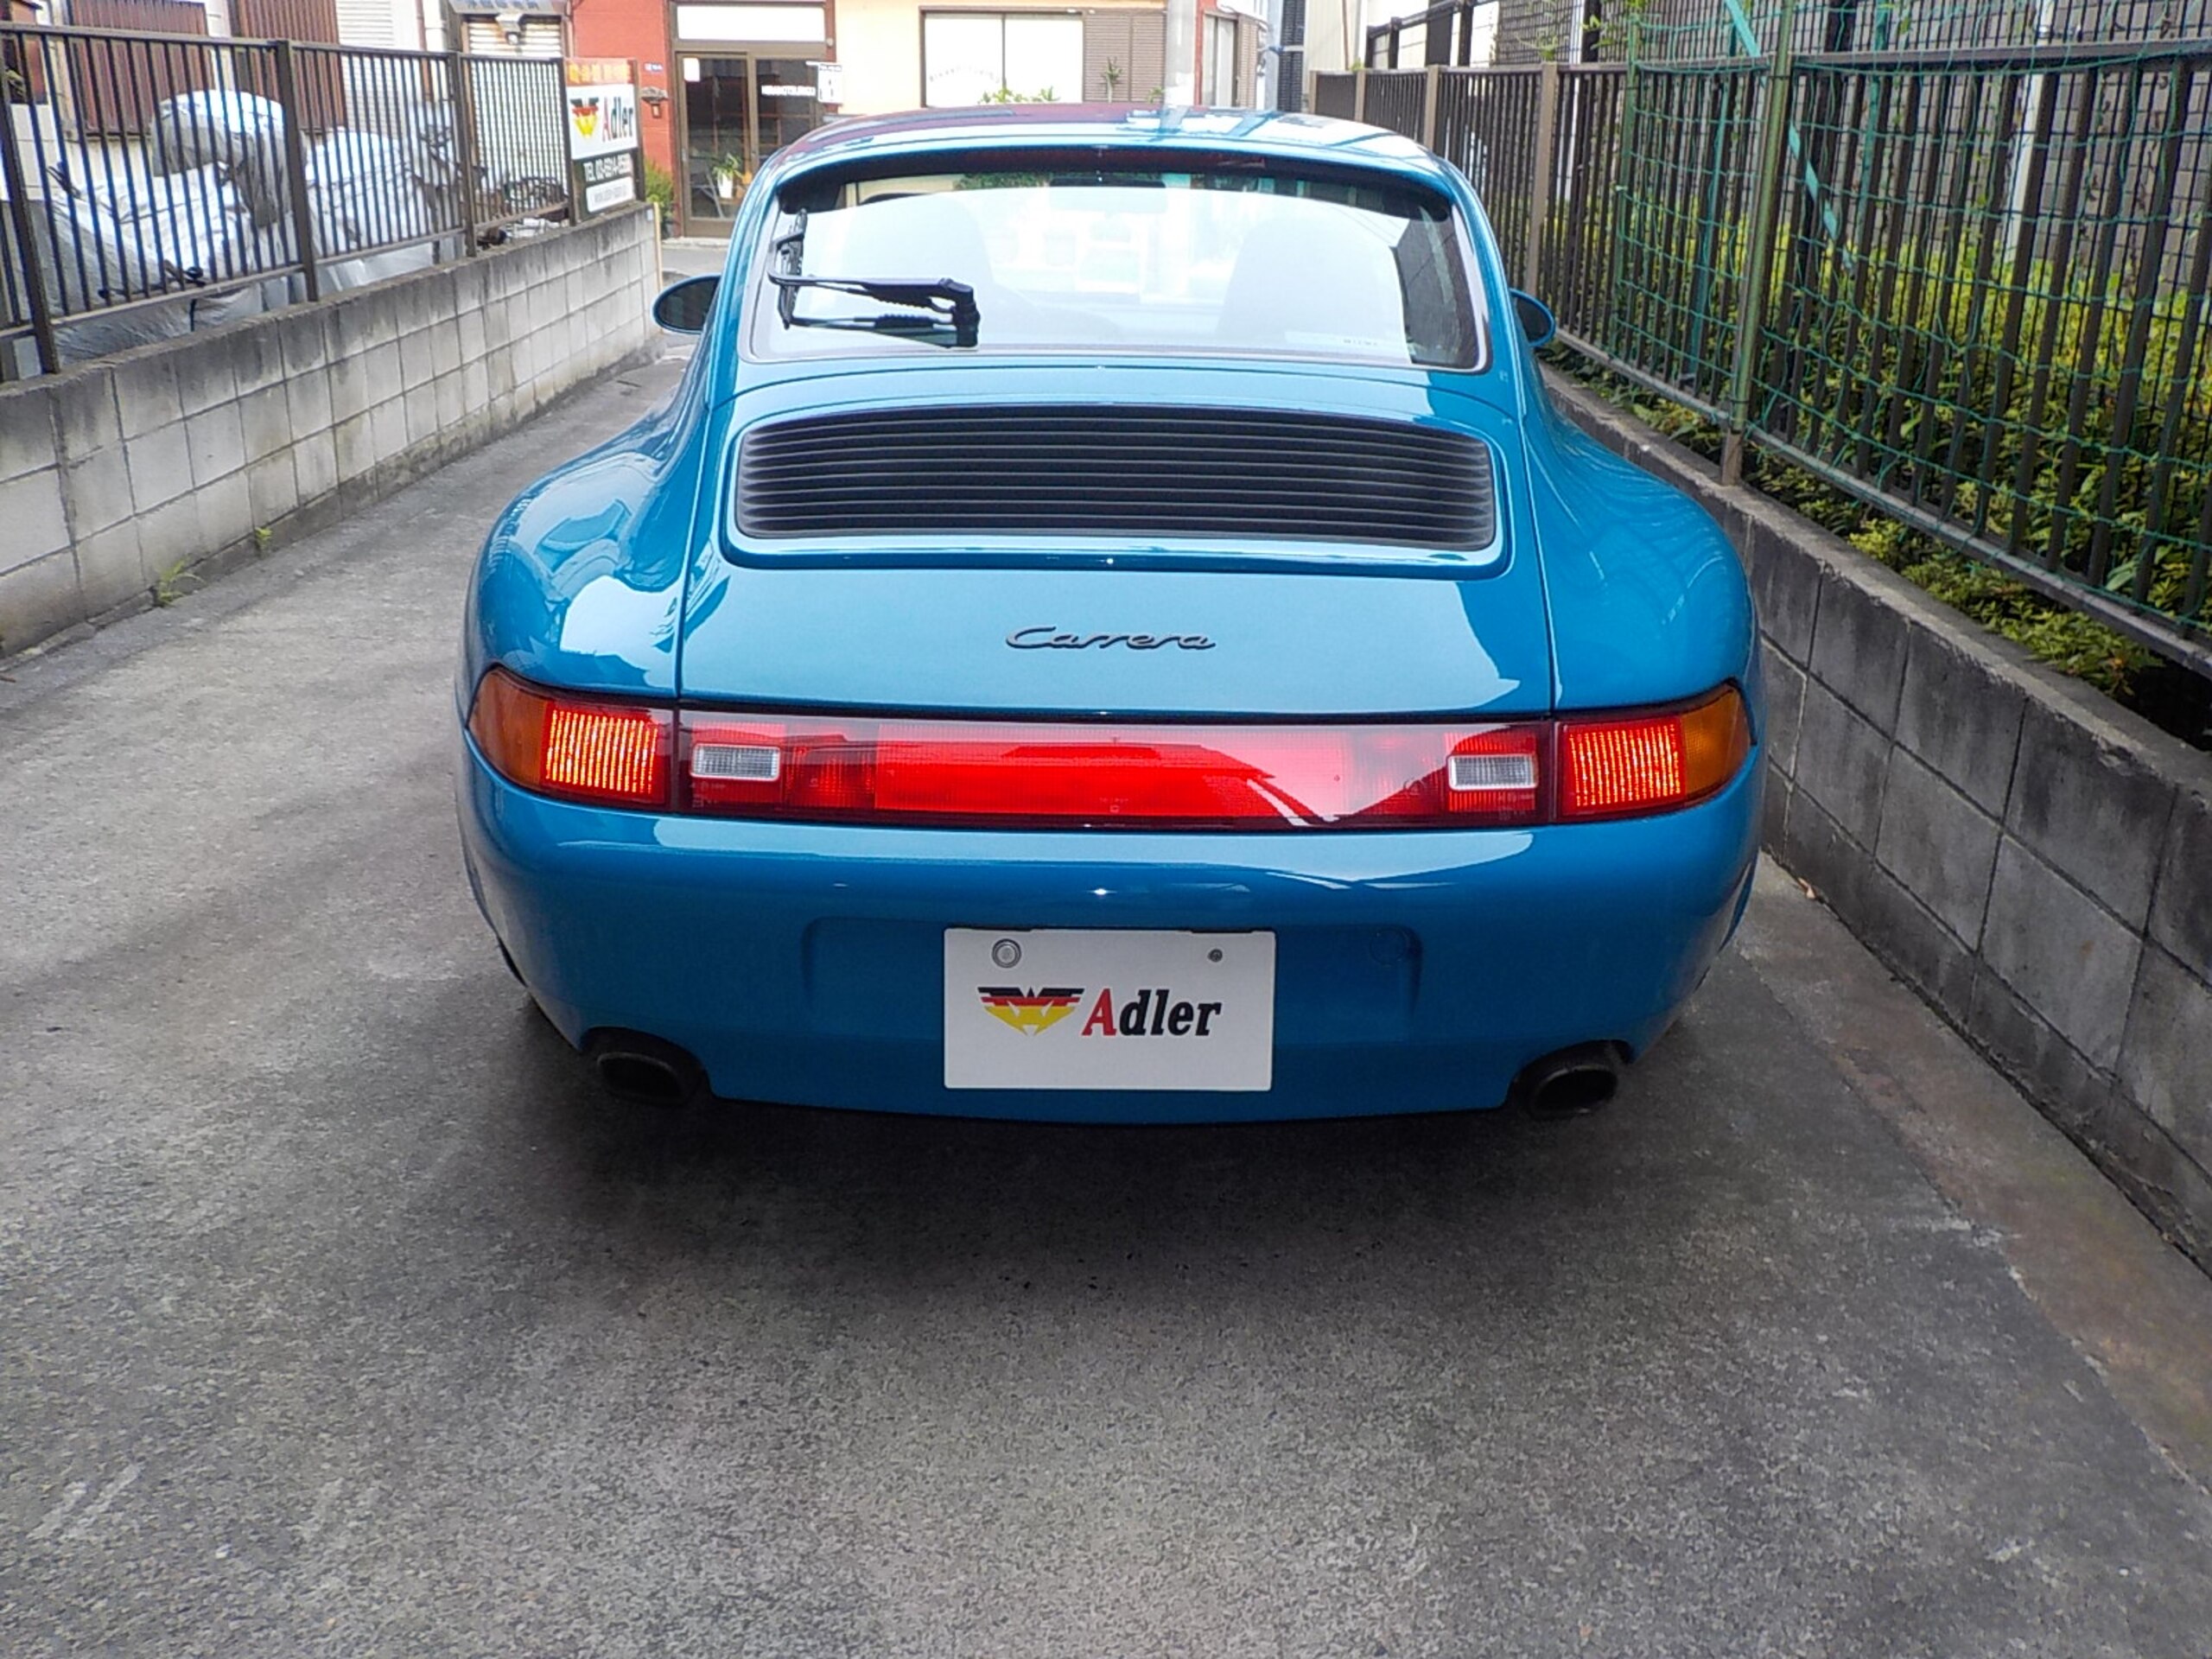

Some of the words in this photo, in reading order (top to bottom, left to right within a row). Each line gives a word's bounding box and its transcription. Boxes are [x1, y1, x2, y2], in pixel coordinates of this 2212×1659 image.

[602, 96, 633, 143] Adler
[1006, 626, 1216, 649] Carrera
[1082, 988, 1223, 1036] Adler
